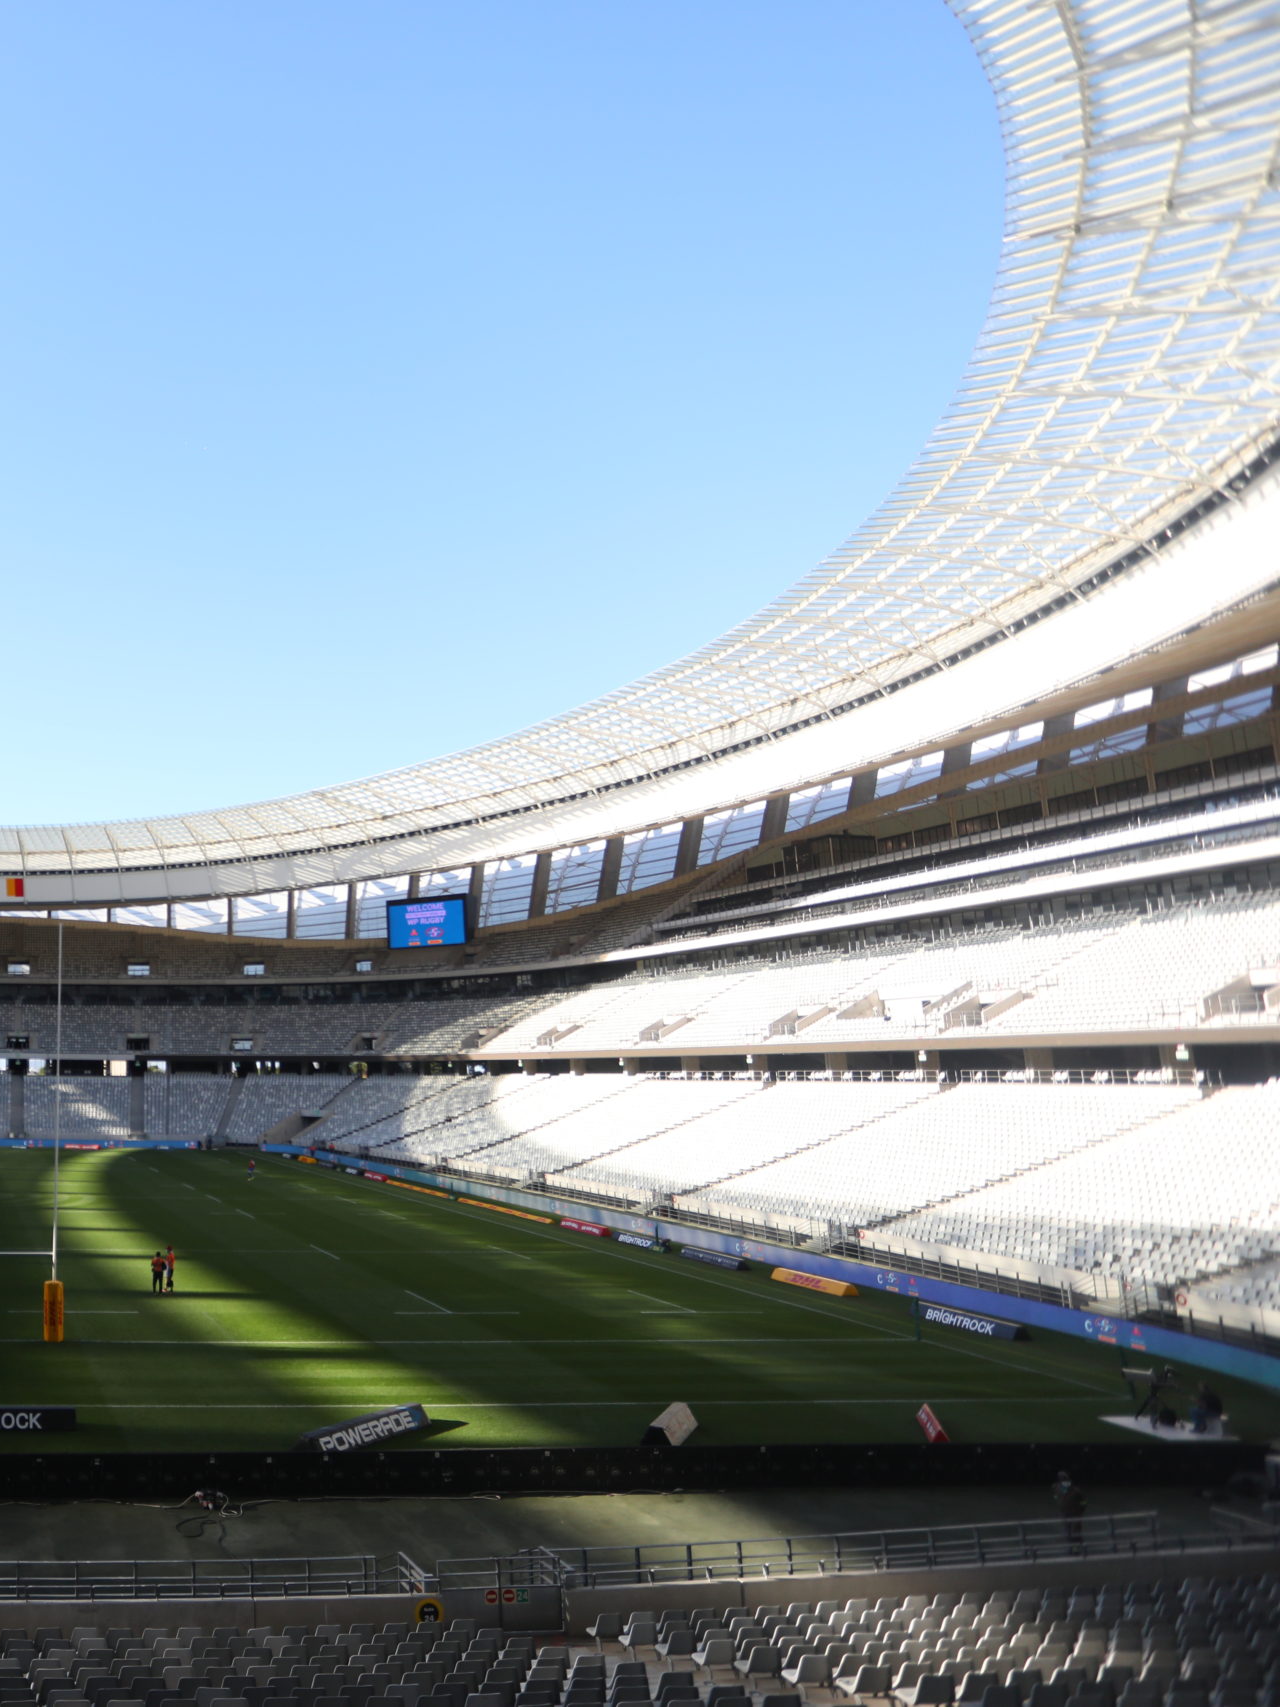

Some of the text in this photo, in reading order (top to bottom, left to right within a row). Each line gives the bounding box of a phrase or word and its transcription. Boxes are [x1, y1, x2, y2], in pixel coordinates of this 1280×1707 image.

[406, 902, 444, 912] WELCOME
[420, 916, 444, 925] RUGBY
[319, 1411, 416, 1451] POWERADE
[517, 1590, 528, 1601] 24
